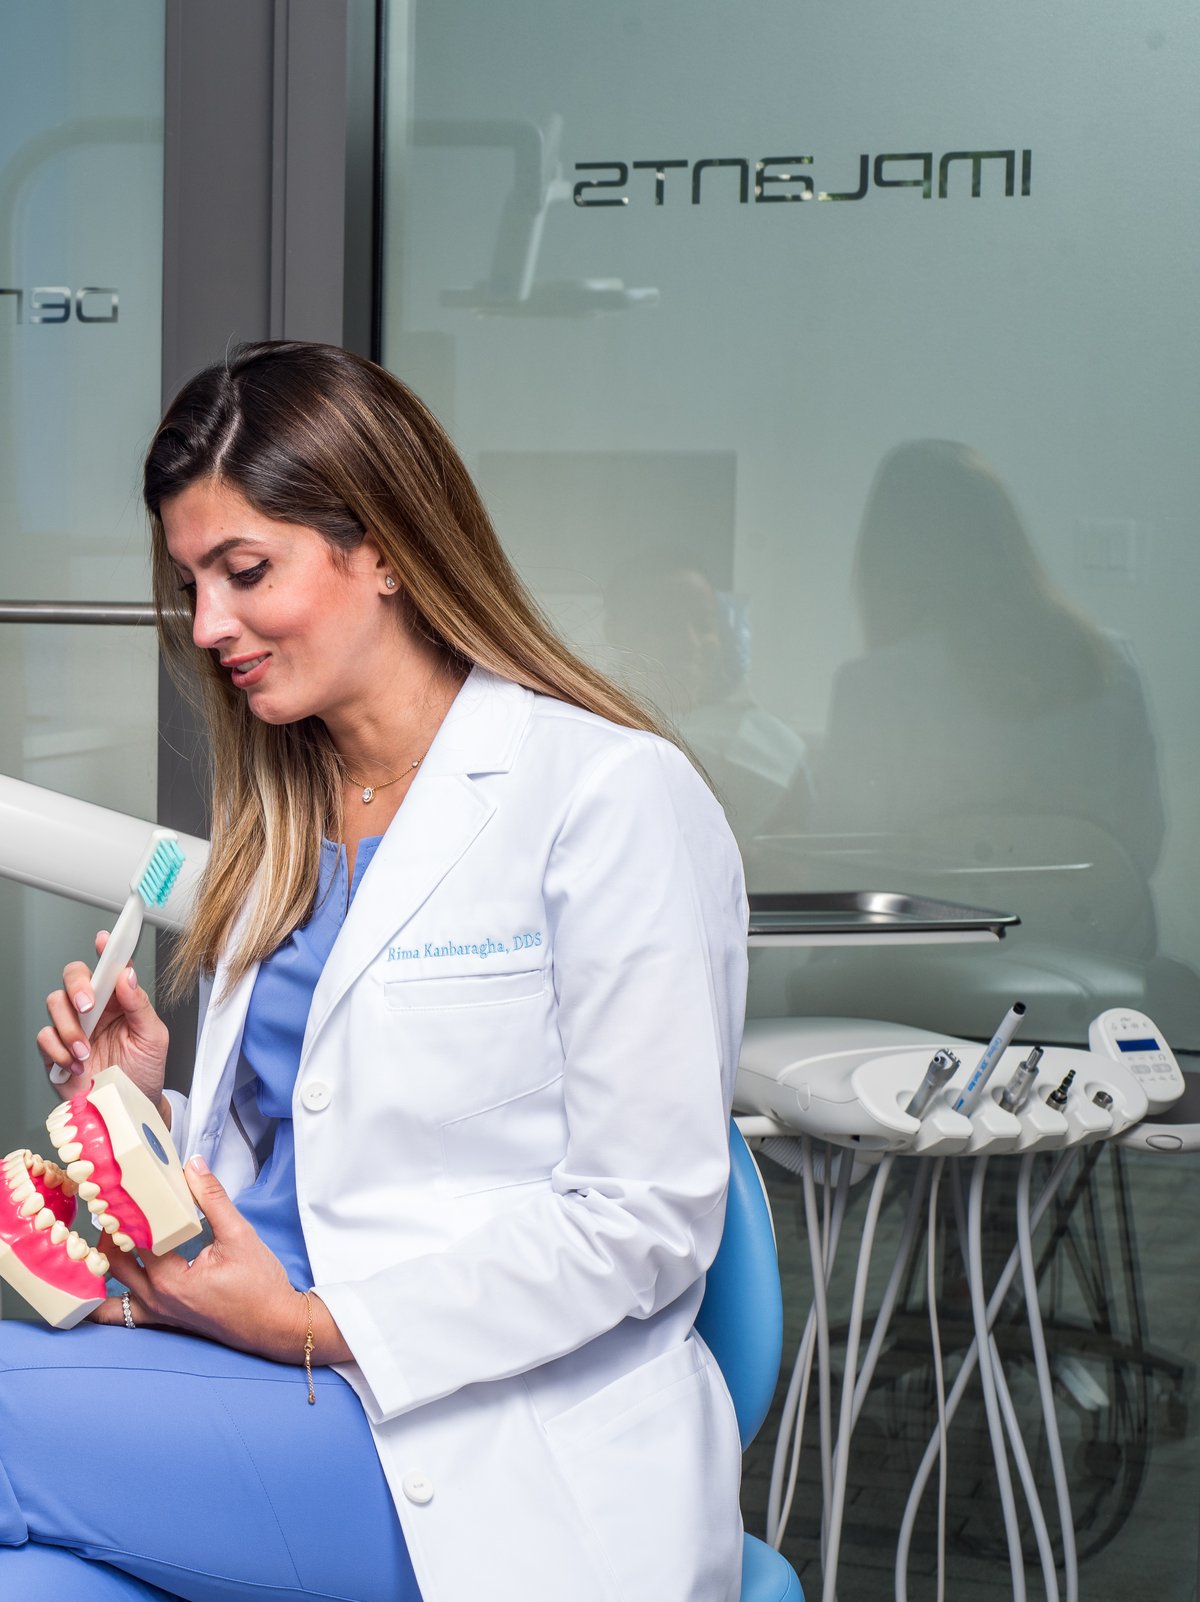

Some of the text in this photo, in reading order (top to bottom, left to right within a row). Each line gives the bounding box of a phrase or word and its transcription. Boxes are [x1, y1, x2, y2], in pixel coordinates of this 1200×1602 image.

[387, 932, 543, 962] Rima Kanbaragha, DDS
